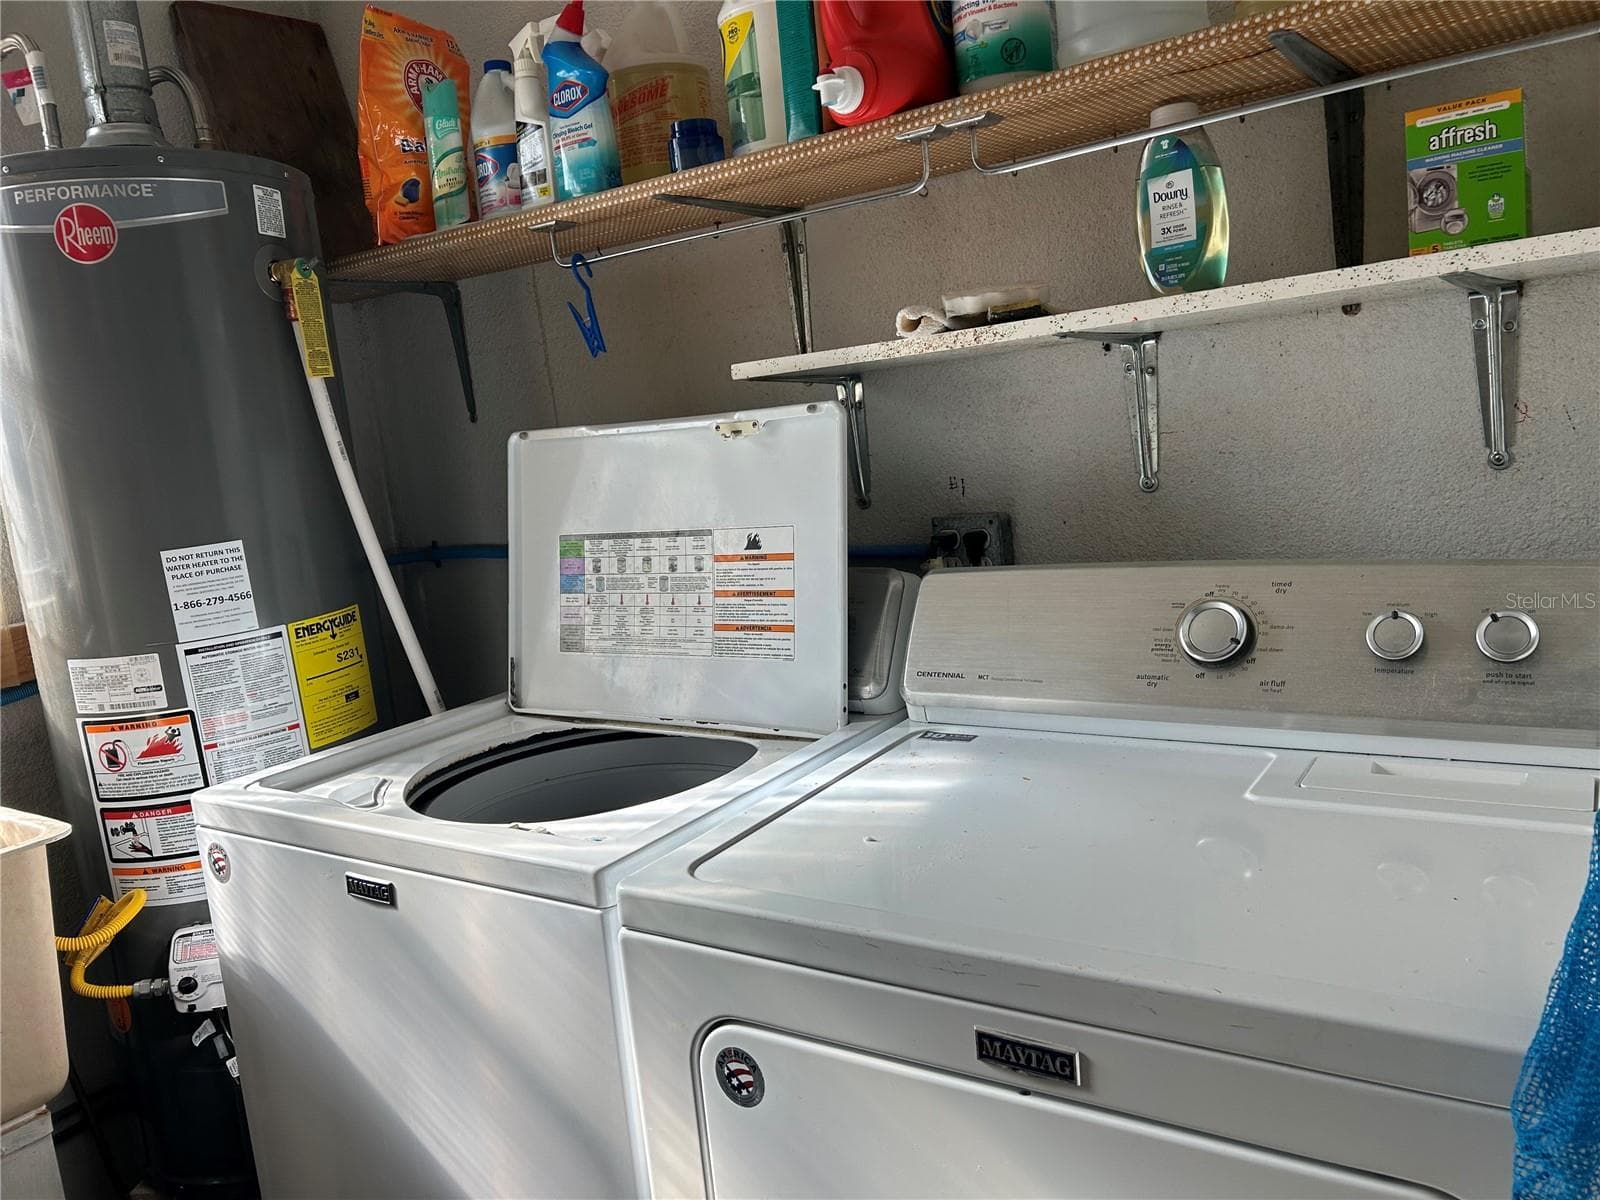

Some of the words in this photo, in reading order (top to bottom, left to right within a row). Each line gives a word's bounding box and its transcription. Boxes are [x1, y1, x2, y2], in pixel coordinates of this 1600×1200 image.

[420, 62, 444, 83] HAM
[553, 85, 583, 106] CLOROX
[1437, 103, 1463, 113] VALUE
[1465, 97, 1487, 106] PACK
[584, 122, 593, 130] Gel
[1429, 120, 1497, 151] affresh
[14, 183, 154, 206] PERFORMANCE
[1153, 187, 1189, 204] Downy
[1162, 203, 1178, 212] RINSE
[60, 207, 115, 254] Rheem
[1160, 226, 1173, 236] 3X
[1431, 244, 1440, 254] 5
[165, 556, 178, 564] DO
[178, 553, 194, 562] NOT
[195, 550, 224, 559] RETURN
[225, 547, 241, 555] THIS
[165, 563, 191, 573] WATER
[192, 559, 219, 569] HEATER
[219, 557, 230, 565] TO
[231, 555, 245, 563] THE
[171, 571, 193, 580] PLACE
[205, 564, 242, 576] PURCHASE
[1271, 580, 1293, 588] timed
[1275, 586, 1288, 595] dry
[173, 590, 252, 612] 1-866-279-4566
[294, 610, 358, 640] ENERGYGUIDE
[1246, 657, 1256, 665] off
[916, 670, 966, 680] CENTENNIAL
[1136, 673, 1170, 681] automatic
[1195, 671, 1206, 679] off
[1146, 681, 1158, 690] dry
[1259, 680, 1270, 688] air
[1270, 680, 1286, 688] fluff
[118, 721, 158, 732] WARNING
[139, 808, 172, 818] DANGER
[152, 864, 186, 874] WARNING
[348, 878, 389, 900] MAYTAG
[981, 1037, 1072, 1077] MAYTAG
